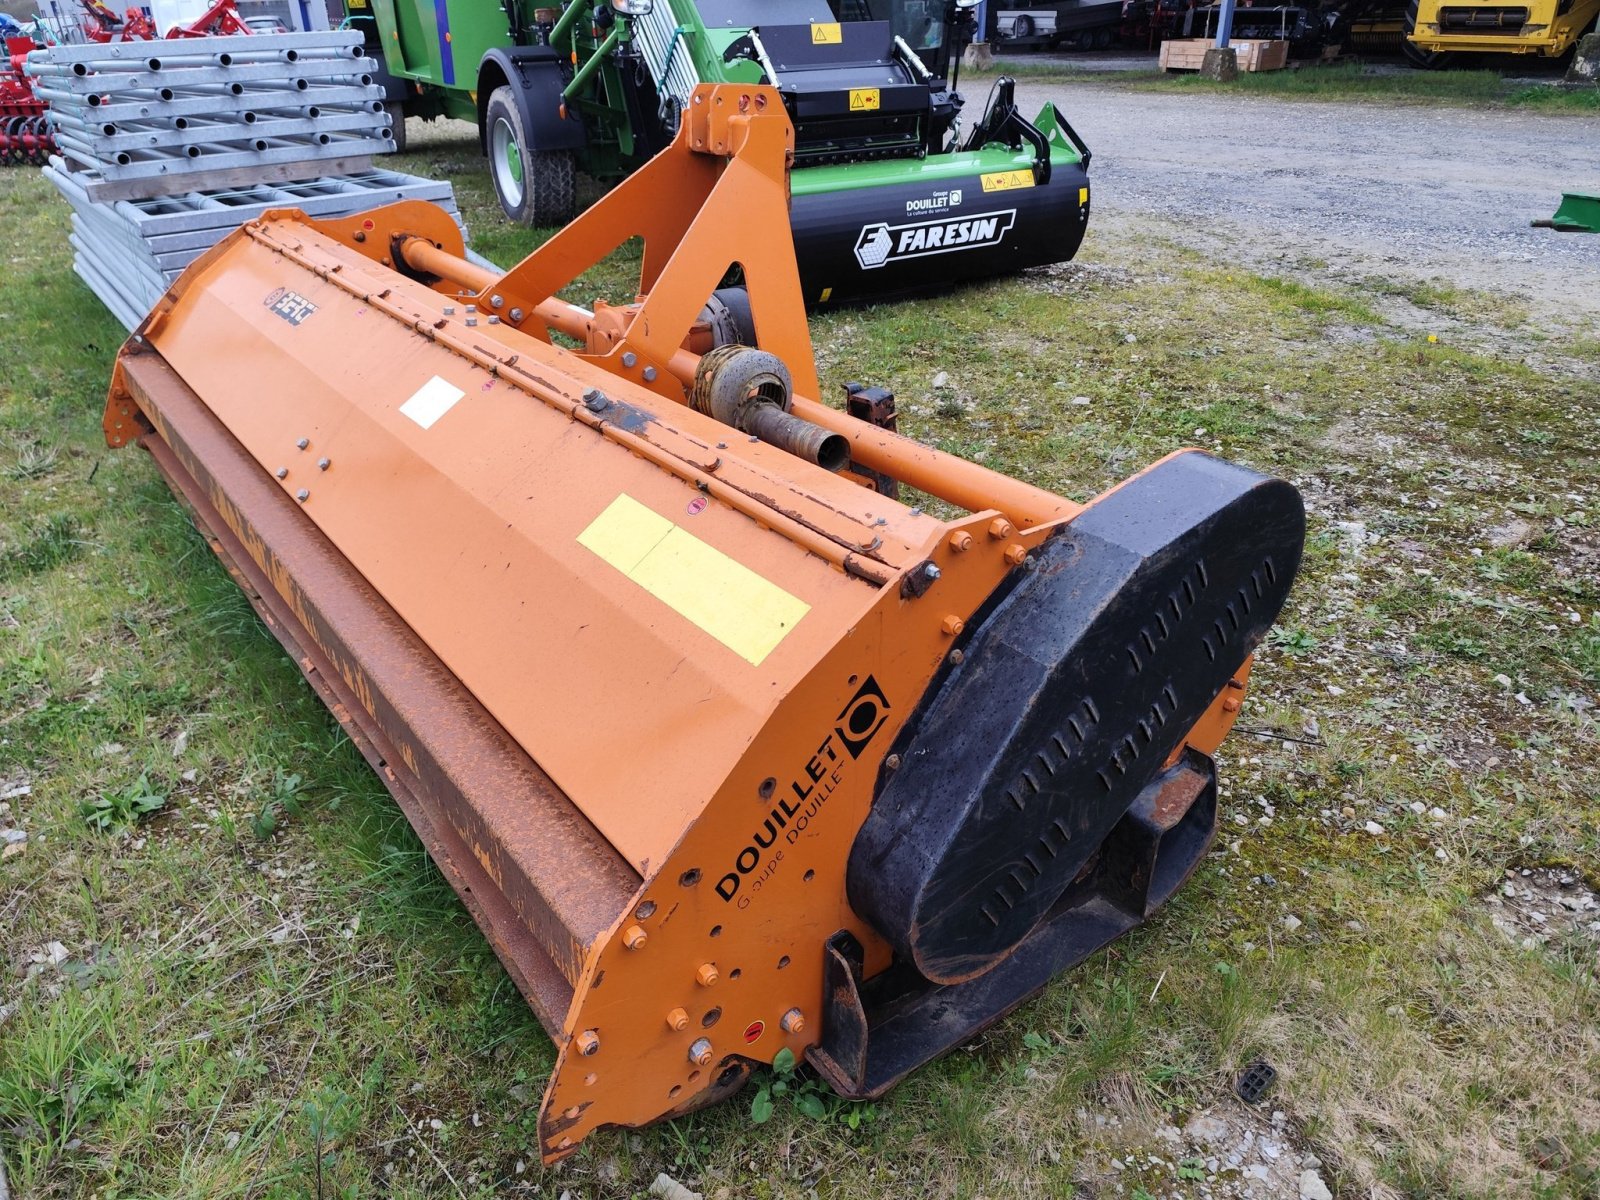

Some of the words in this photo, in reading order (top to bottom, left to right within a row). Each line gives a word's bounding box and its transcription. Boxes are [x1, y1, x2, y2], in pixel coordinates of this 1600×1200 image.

[906, 197, 948, 212] DOUILLET
[896, 217, 999, 253] FARESIN
[715, 734, 838, 903] DOUILLET
[737, 850, 785, 910] Goupe
